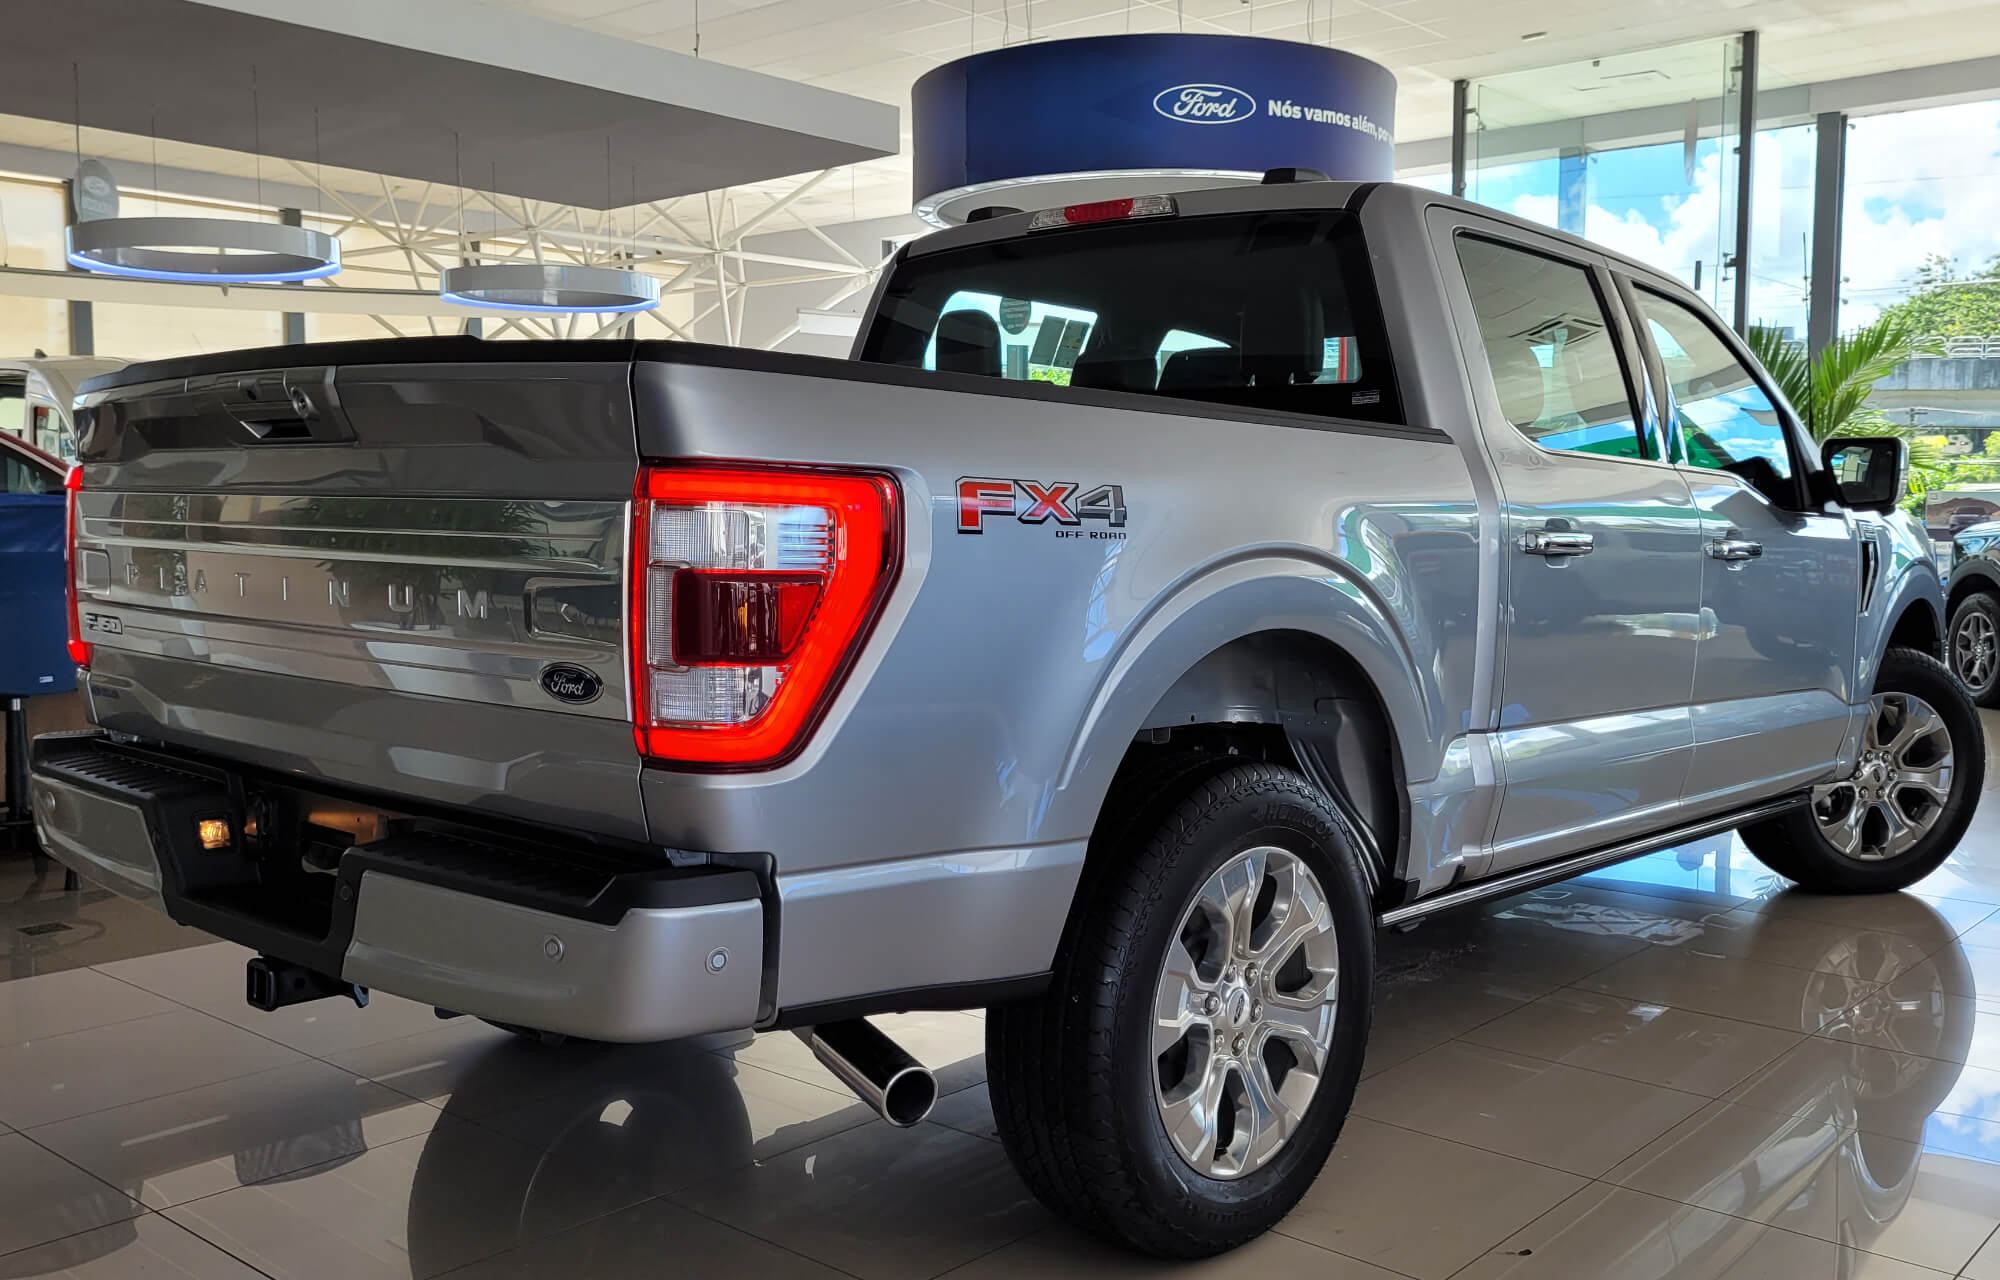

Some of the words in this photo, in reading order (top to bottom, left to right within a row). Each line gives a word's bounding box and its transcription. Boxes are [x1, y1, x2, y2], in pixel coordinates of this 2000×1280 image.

[1173, 88, 1238, 118] Ford
[1267, 99, 1302, 119] Nós
[1304, 106, 1351, 127] vamos
[1351, 114, 1378, 140] além,
[955, 476, 1127, 535] FX4
[1055, 530, 1085, 540] OFF
[1089, 531, 1128, 541] ROAD
[125, 560, 488, 621] PLATINUM
[550, 672, 585, 697] Ford
